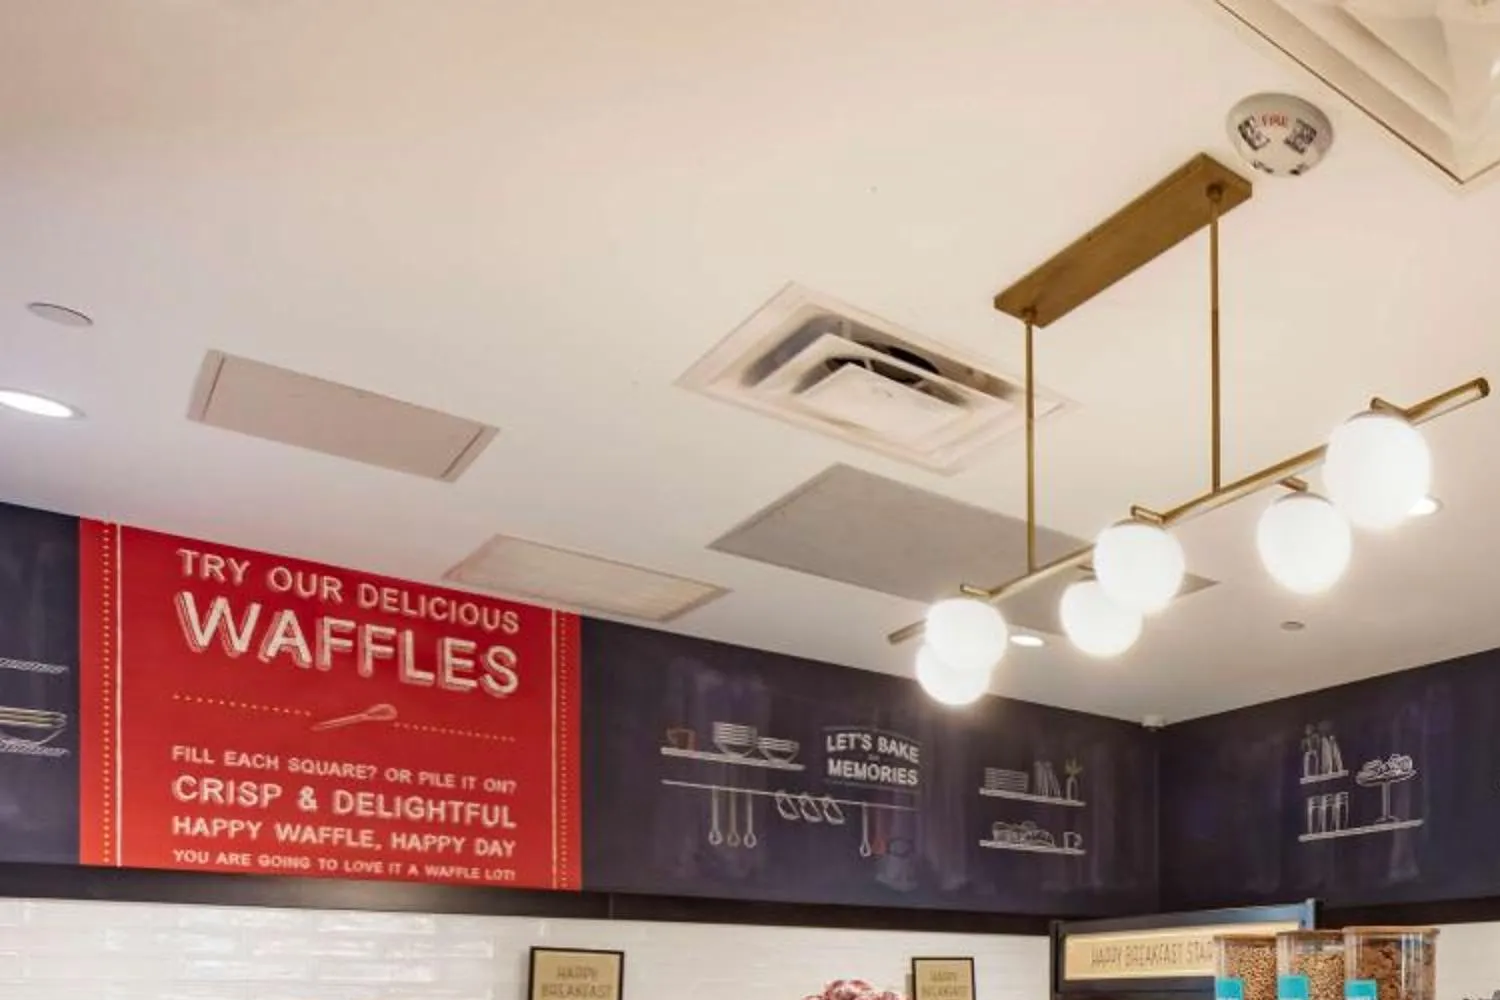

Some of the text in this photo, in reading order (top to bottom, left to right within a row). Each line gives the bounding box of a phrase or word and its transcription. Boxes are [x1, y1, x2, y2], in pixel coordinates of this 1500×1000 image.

[176, 548, 520, 634] TRY OUR DELICIOUS
[174, 591, 518, 698] WAFFLES
[826, 733, 920, 764] LET'S BAKE
[172, 745, 517, 795] FILL EACH SQUARE? OR PILE IT ON?
[827, 758, 918, 786] MEMORIES
[172, 774, 517, 829] CRISP & DELIGHTFUL
[172, 816, 517, 858] HAPPY WAFFLE, HAPPY DAY
[172, 849, 209, 864] YOU
[215, 851, 252, 867] ARE
[258, 854, 311, 870] GOING
[318, 858, 338, 872] TO
[343, 860, 384, 874] LOVE
[388, 862, 402, 876] IT
[407, 864, 419, 877] A
[424, 864, 480, 880] WAFFLE
[1125, 942, 1183, 967] BREAKFAST
